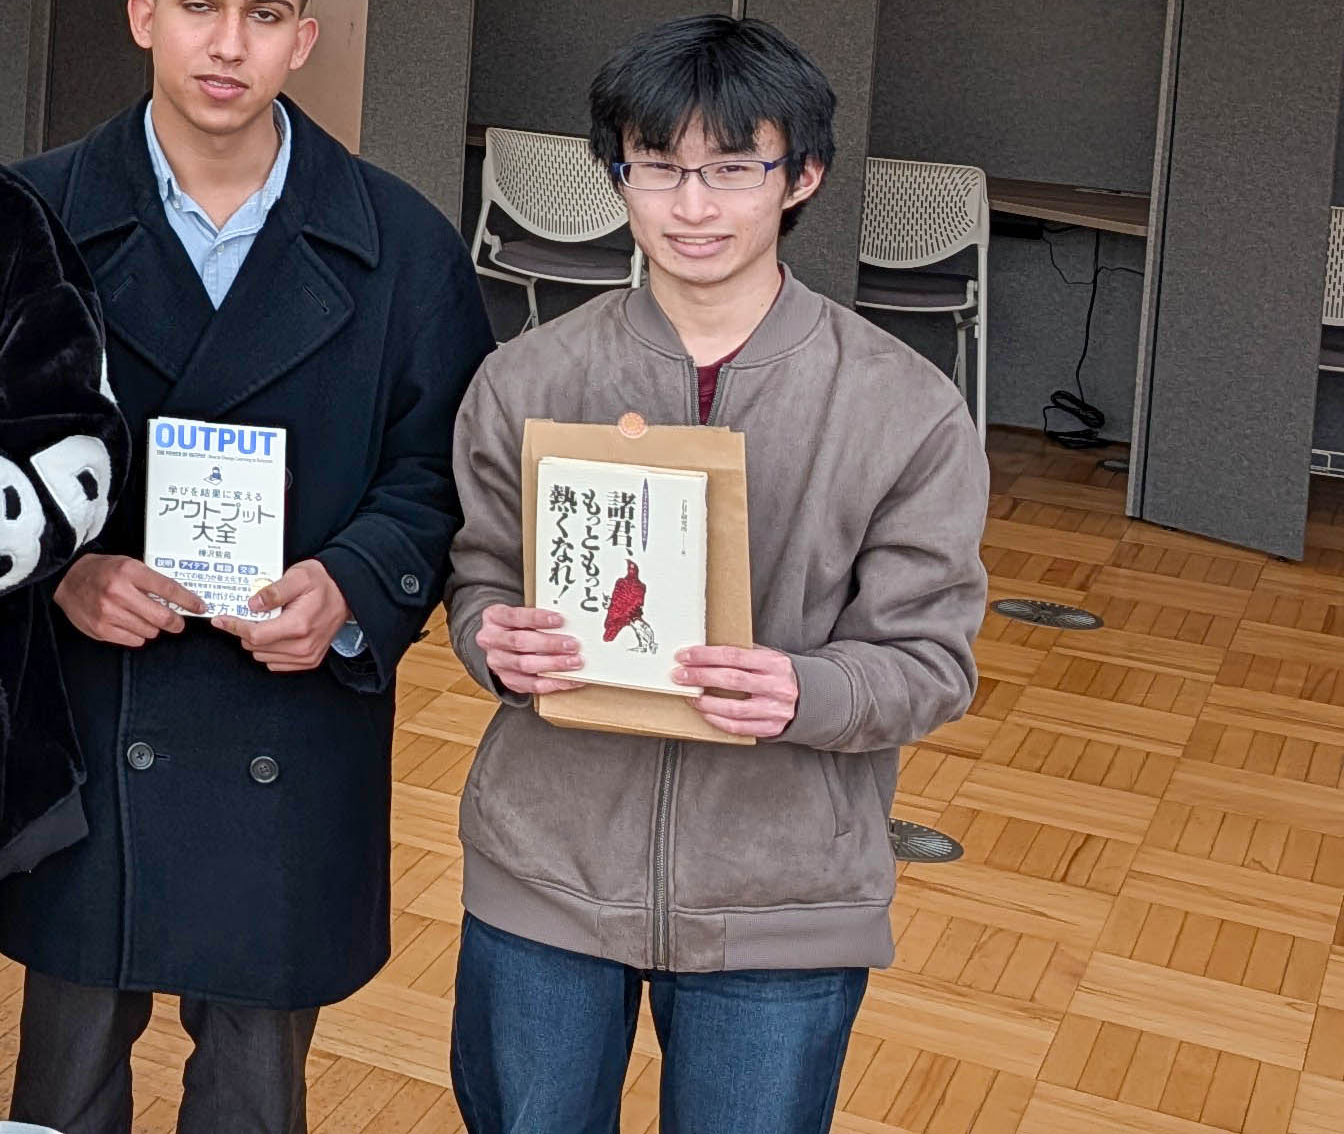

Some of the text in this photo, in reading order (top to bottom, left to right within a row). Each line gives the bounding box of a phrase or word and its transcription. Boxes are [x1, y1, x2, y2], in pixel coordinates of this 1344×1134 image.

[155, 422, 278, 456] OUTPUT
[168, 485, 263, 502] 学びを結果に変える
[158, 496, 276, 525] アウトプット
[606, 490, 637, 556] 諸君、
[192, 521, 238, 545] 大全
[579, 488, 602, 613] もっともっと
